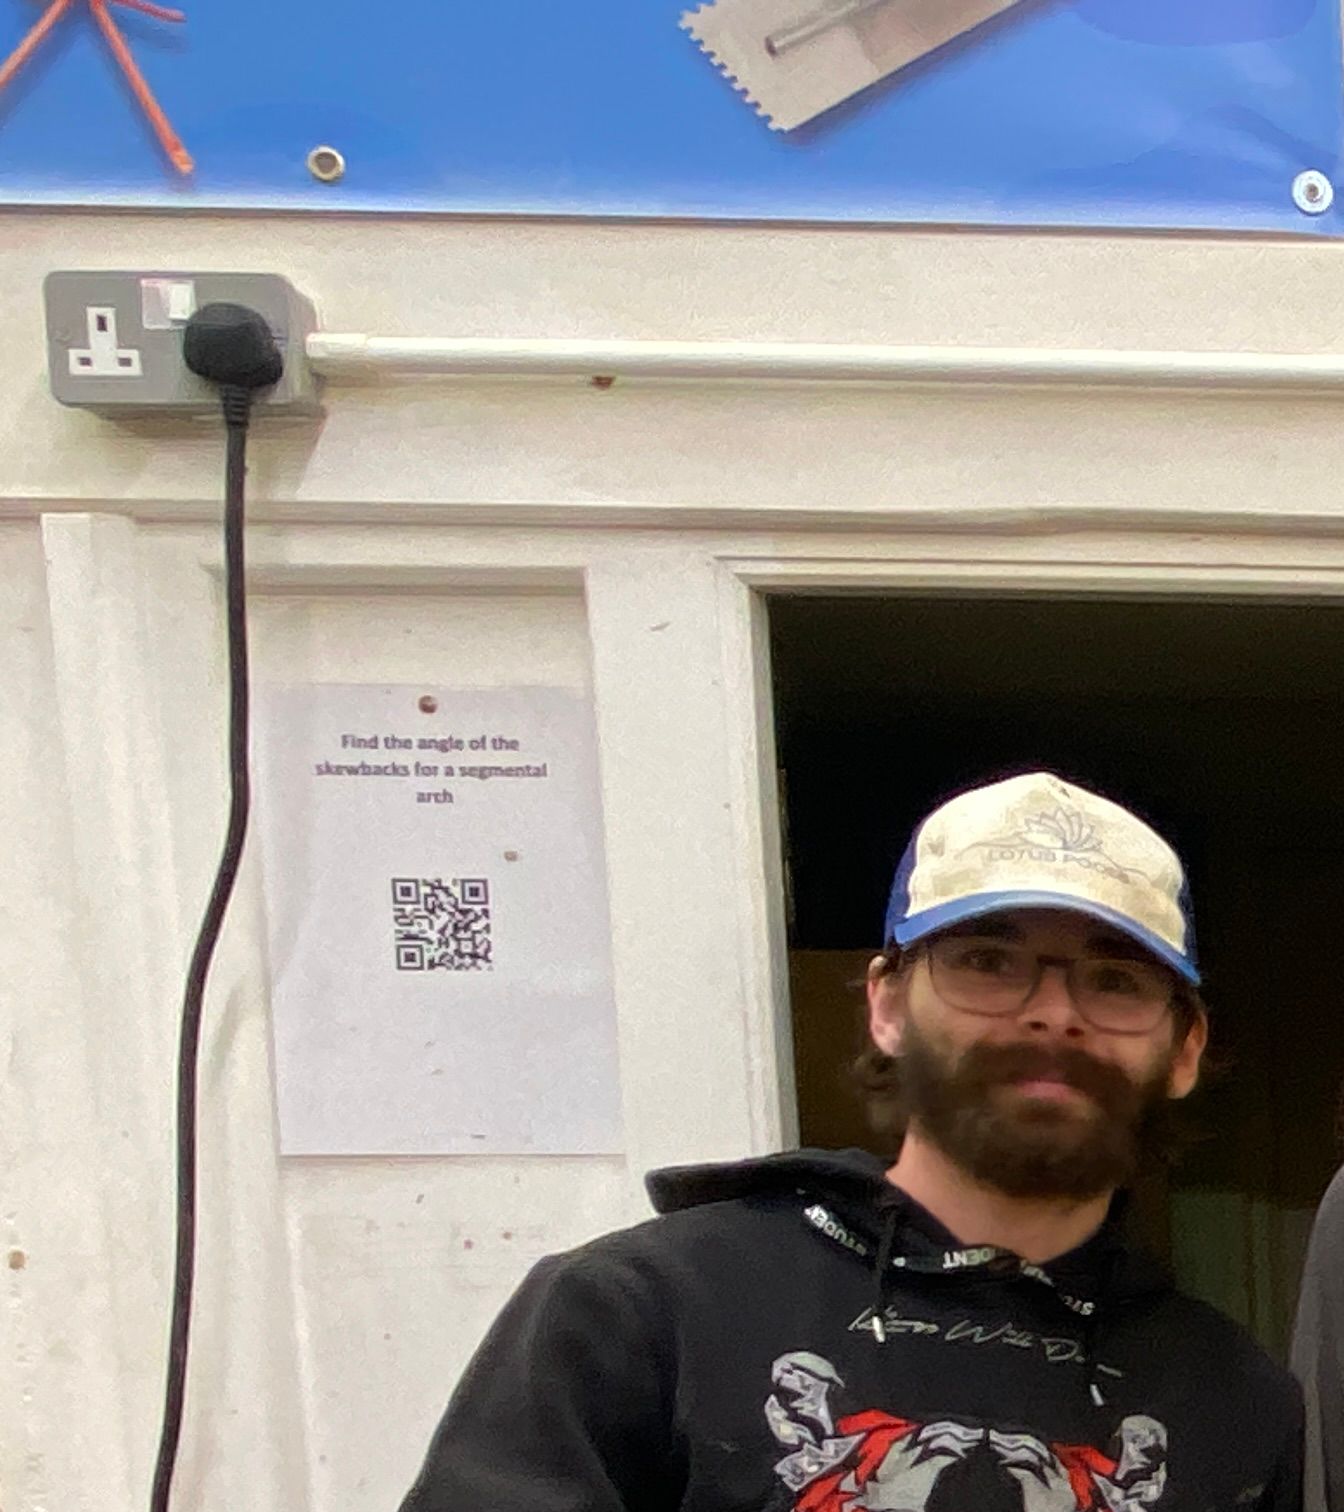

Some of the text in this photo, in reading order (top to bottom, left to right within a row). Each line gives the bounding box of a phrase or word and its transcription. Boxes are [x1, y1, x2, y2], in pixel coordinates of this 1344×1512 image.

[341, 734, 520, 753] Find the angle of the
[315, 762, 548, 780] skewbacks for a segmental
[416, 789, 454, 804] arch
